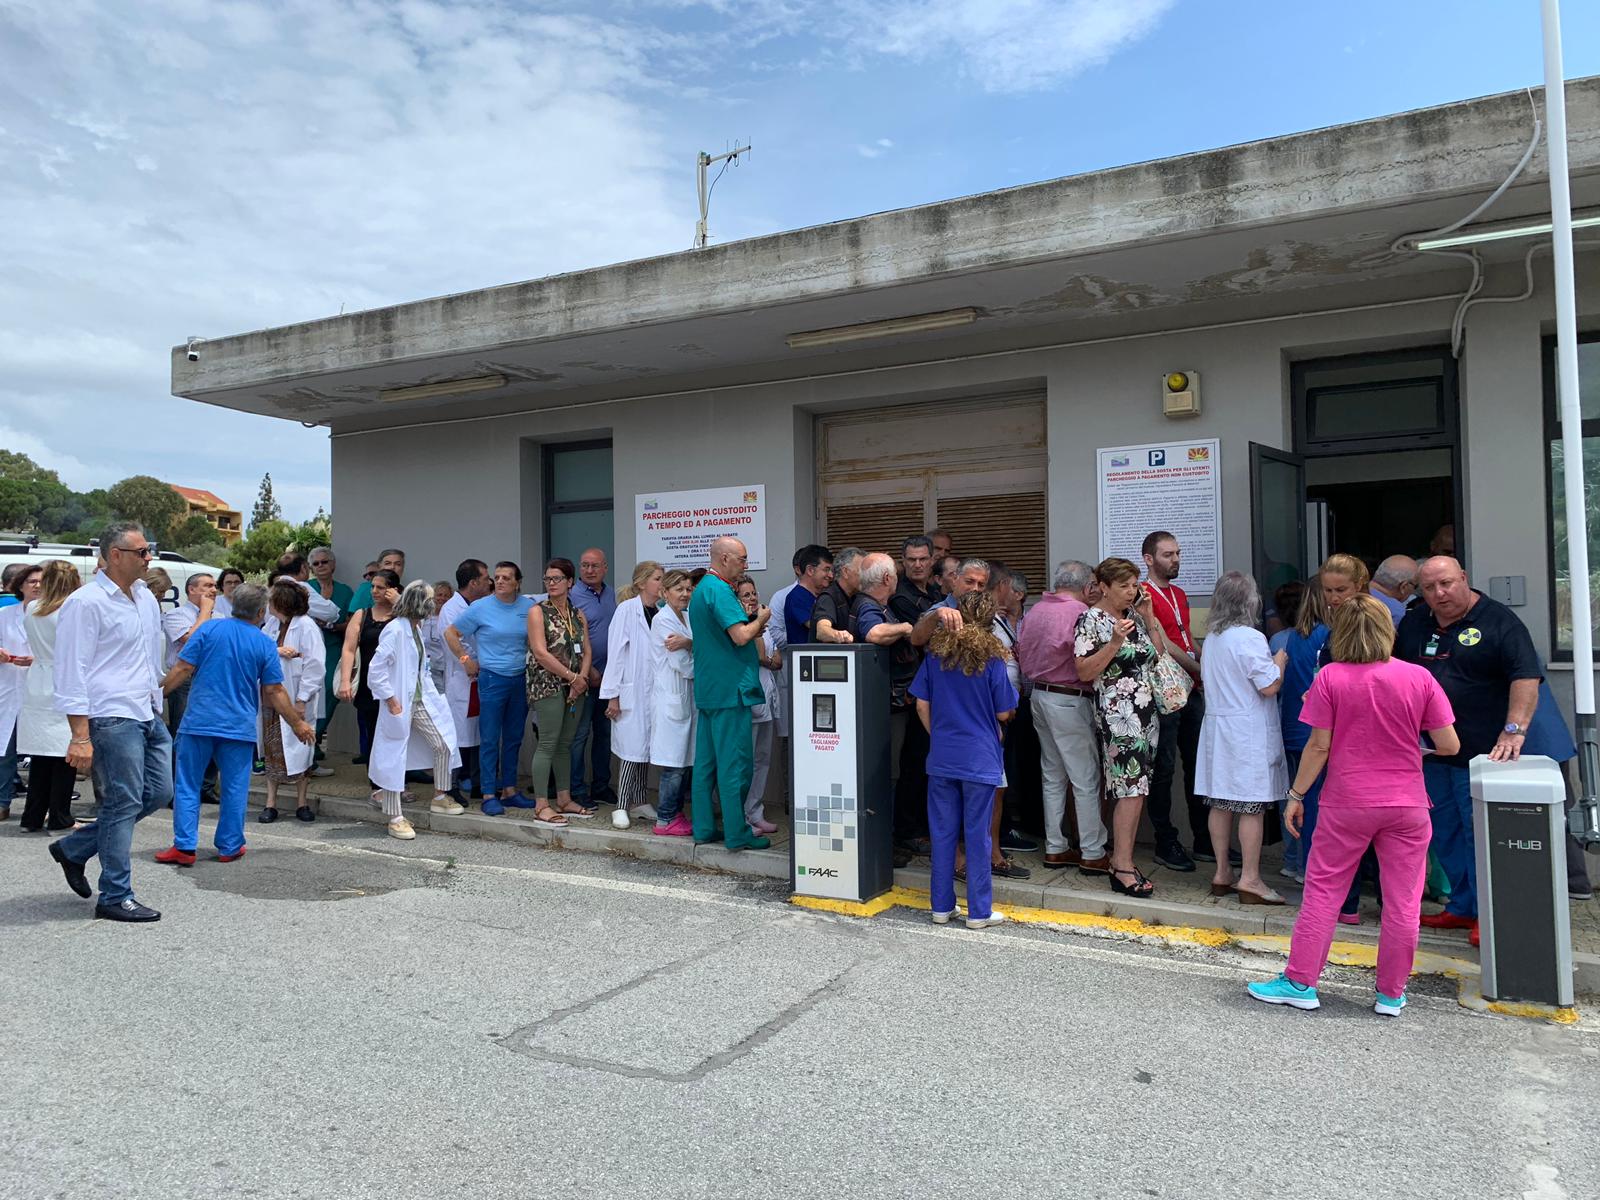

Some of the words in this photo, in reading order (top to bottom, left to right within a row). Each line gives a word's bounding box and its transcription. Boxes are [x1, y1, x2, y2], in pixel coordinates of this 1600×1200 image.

[1152, 452, 1163, 466] P
[642, 510, 691, 520] PARCHEGGIO
[712, 505, 758, 515] CUSTODITO
[704, 517, 752, 526] PAGAMENTO
[1508, 840, 1542, 850] HUB
[809, 868, 838, 878] FAAC
